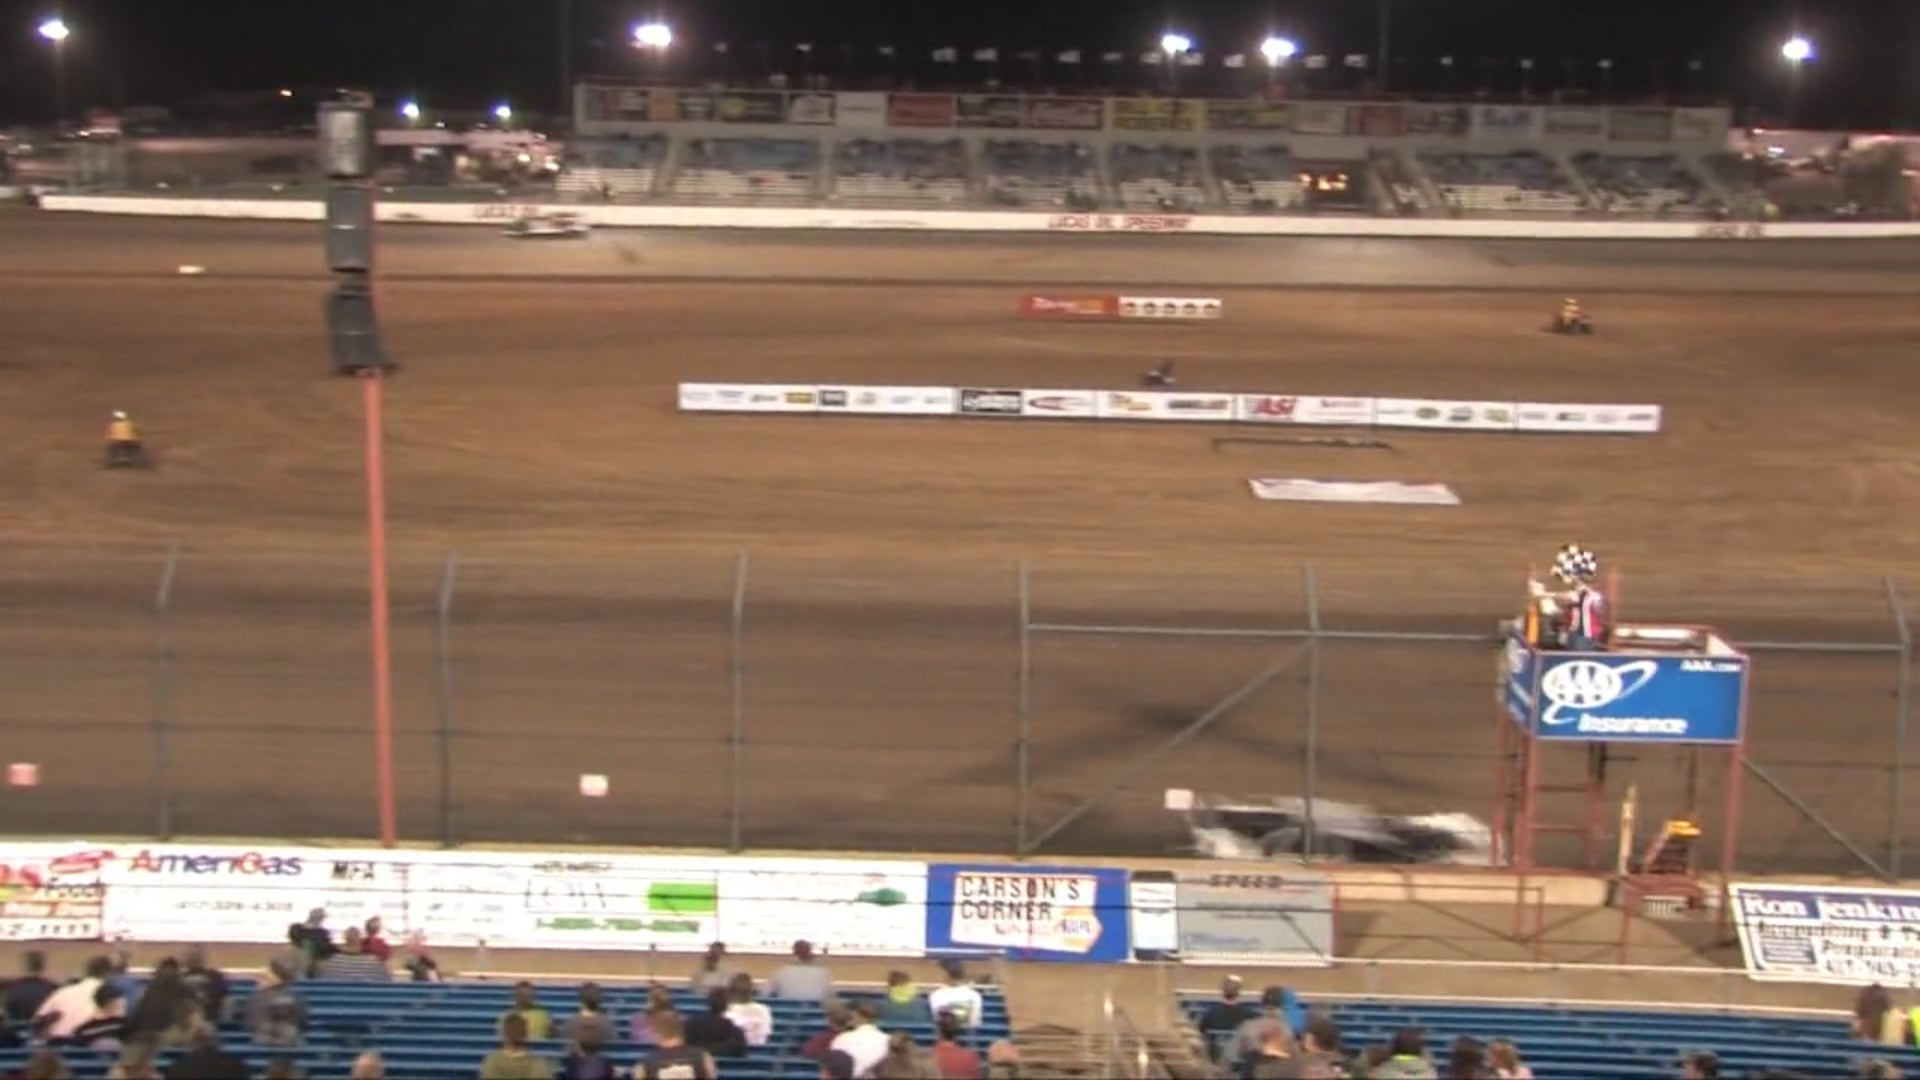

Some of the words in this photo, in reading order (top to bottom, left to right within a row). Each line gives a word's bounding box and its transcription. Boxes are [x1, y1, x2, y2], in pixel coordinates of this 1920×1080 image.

[1577, 713, 1689, 734] Insurance
[128, 850, 302, 876] AmeriGas
[960, 876, 1081, 901] CARSON'S
[960, 900, 1053, 921] CORNER
[1742, 893, 1808, 917] Ron
